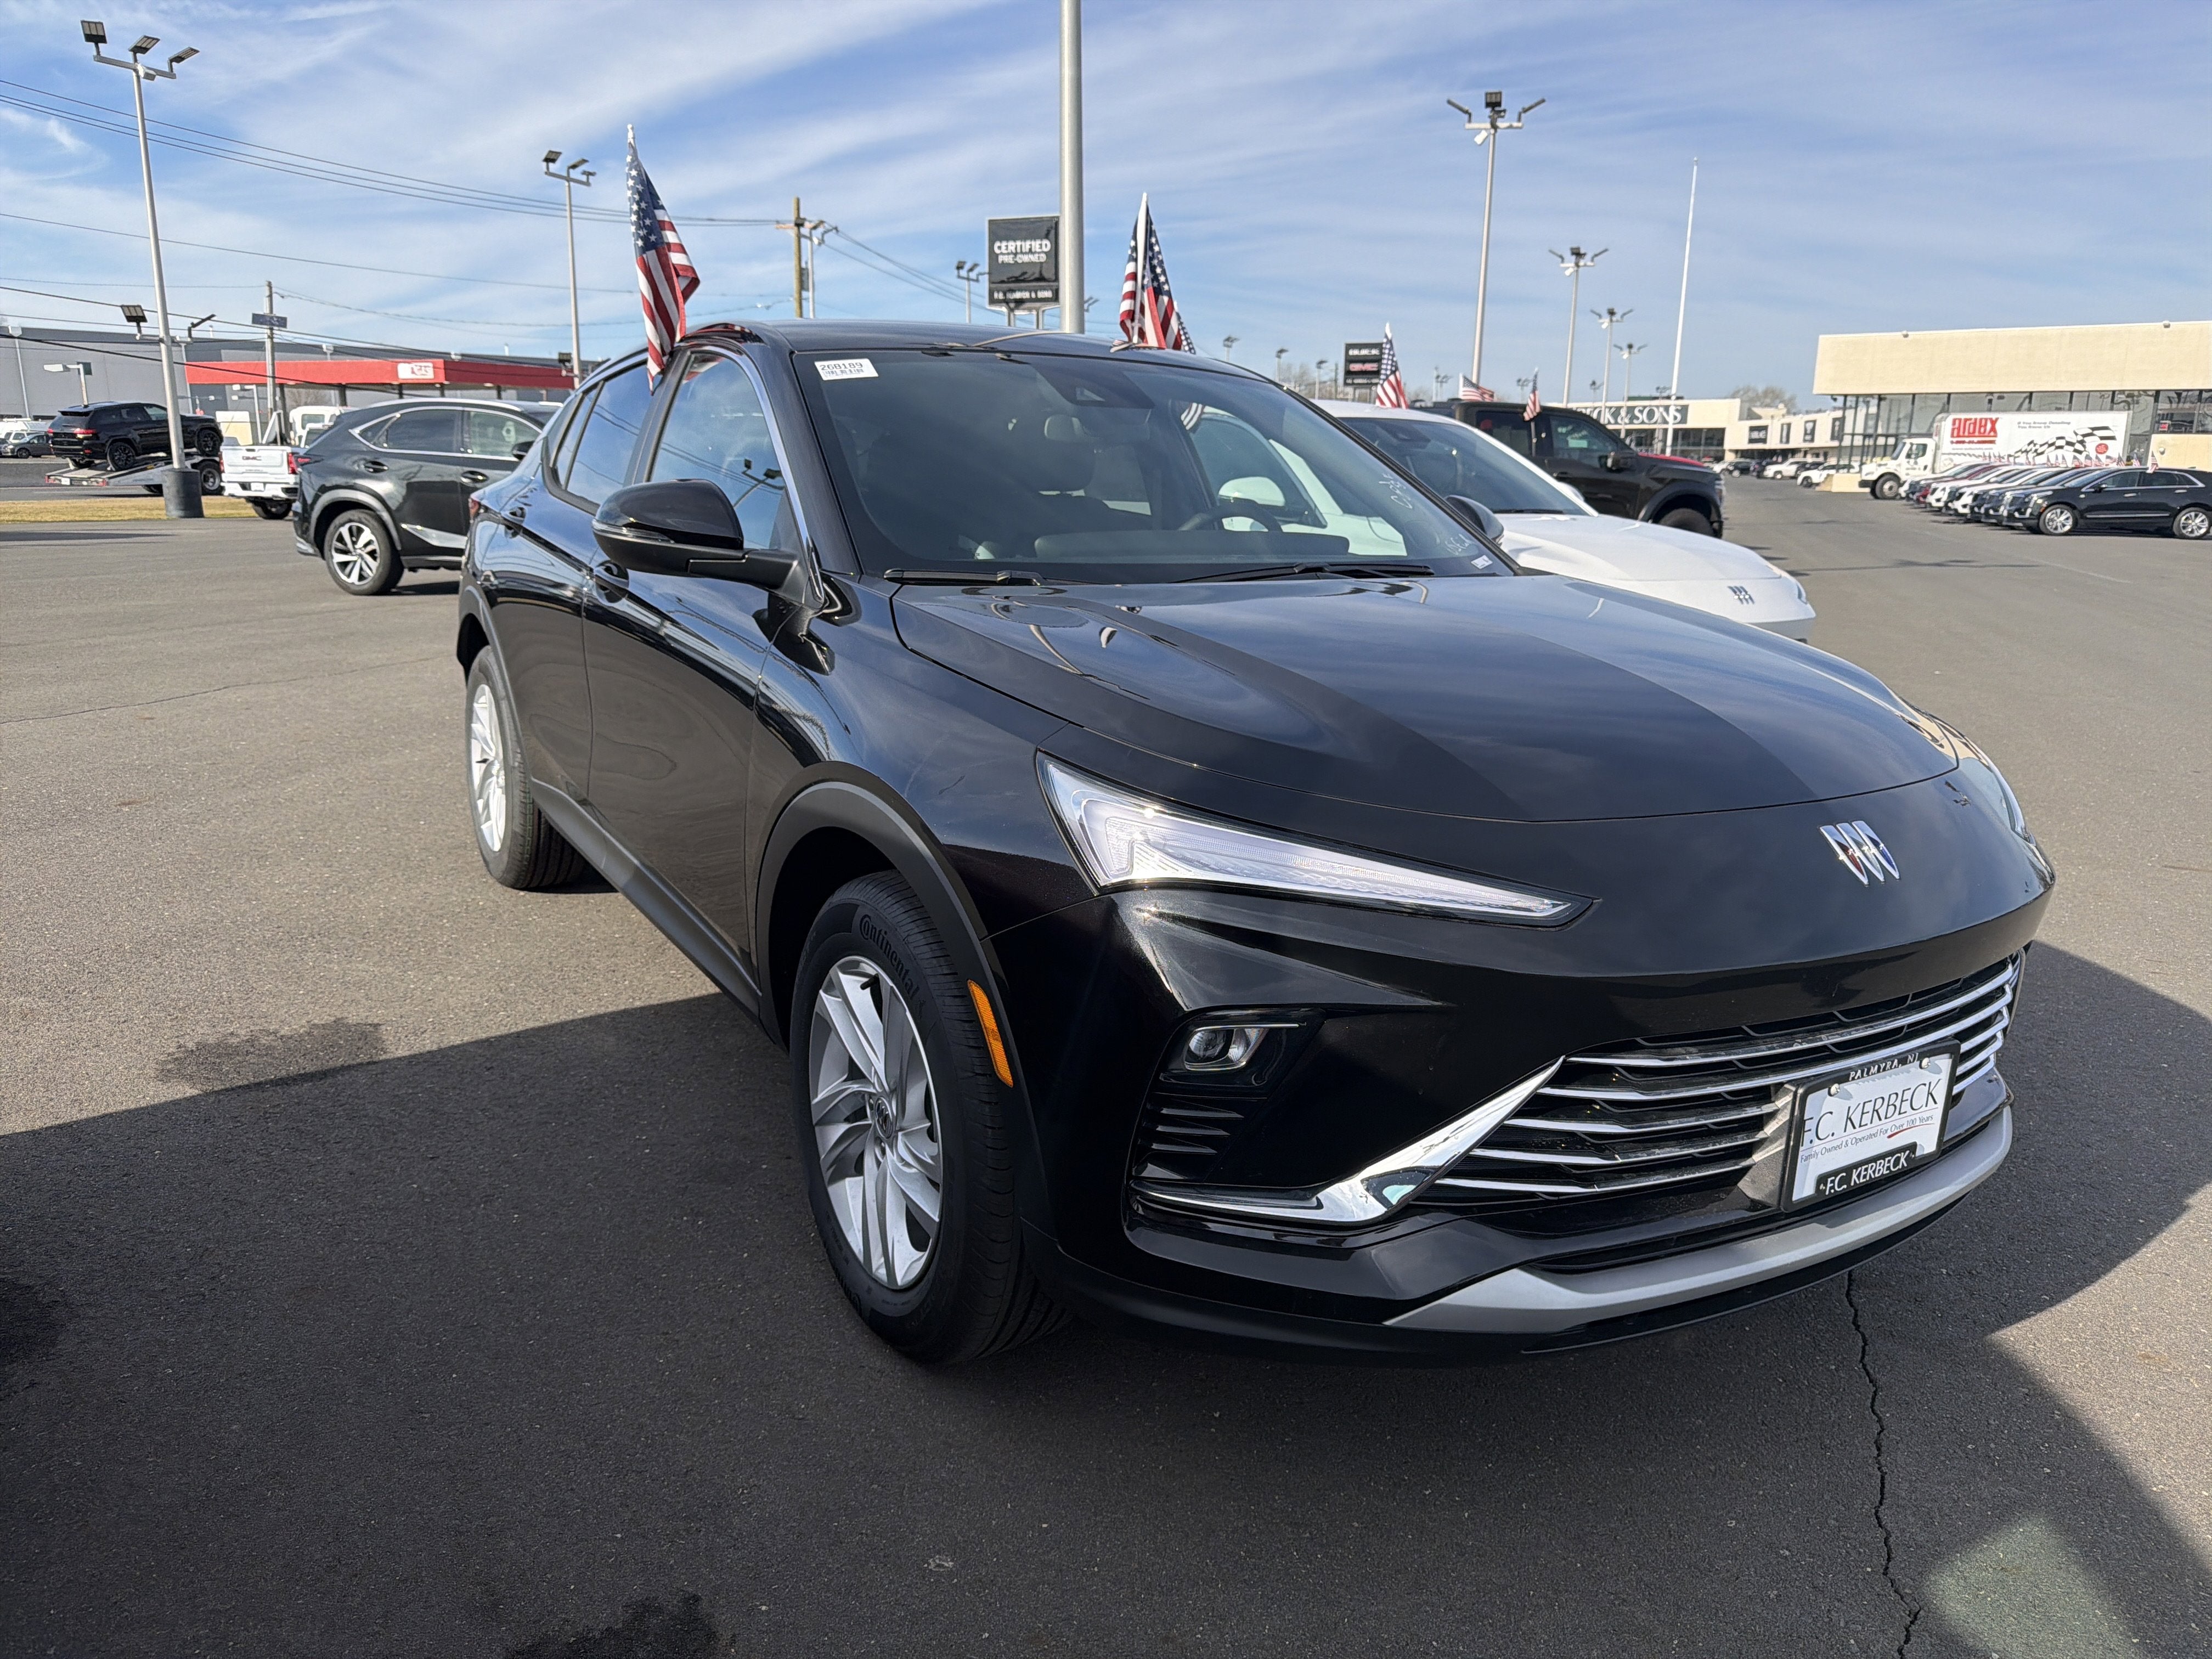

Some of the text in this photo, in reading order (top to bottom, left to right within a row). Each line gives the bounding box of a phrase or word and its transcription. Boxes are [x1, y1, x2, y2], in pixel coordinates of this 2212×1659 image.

[994, 238, 1052, 253] CERTIFIED
[998, 252, 1047, 264] PRE-OWNED
[1633, 406, 1682, 424] SONS
[859, 914, 919, 1000] Continental
[1848, 1052, 1920, 1081] PALMYRA, NJ
[1800, 1078, 1943, 1147] F.C. KERBECK
[1800, 1114, 1934, 1164] Family Owned & Operated For Over 100 Years
[1825, 1149, 1910, 1195] F.C. KERBECK
